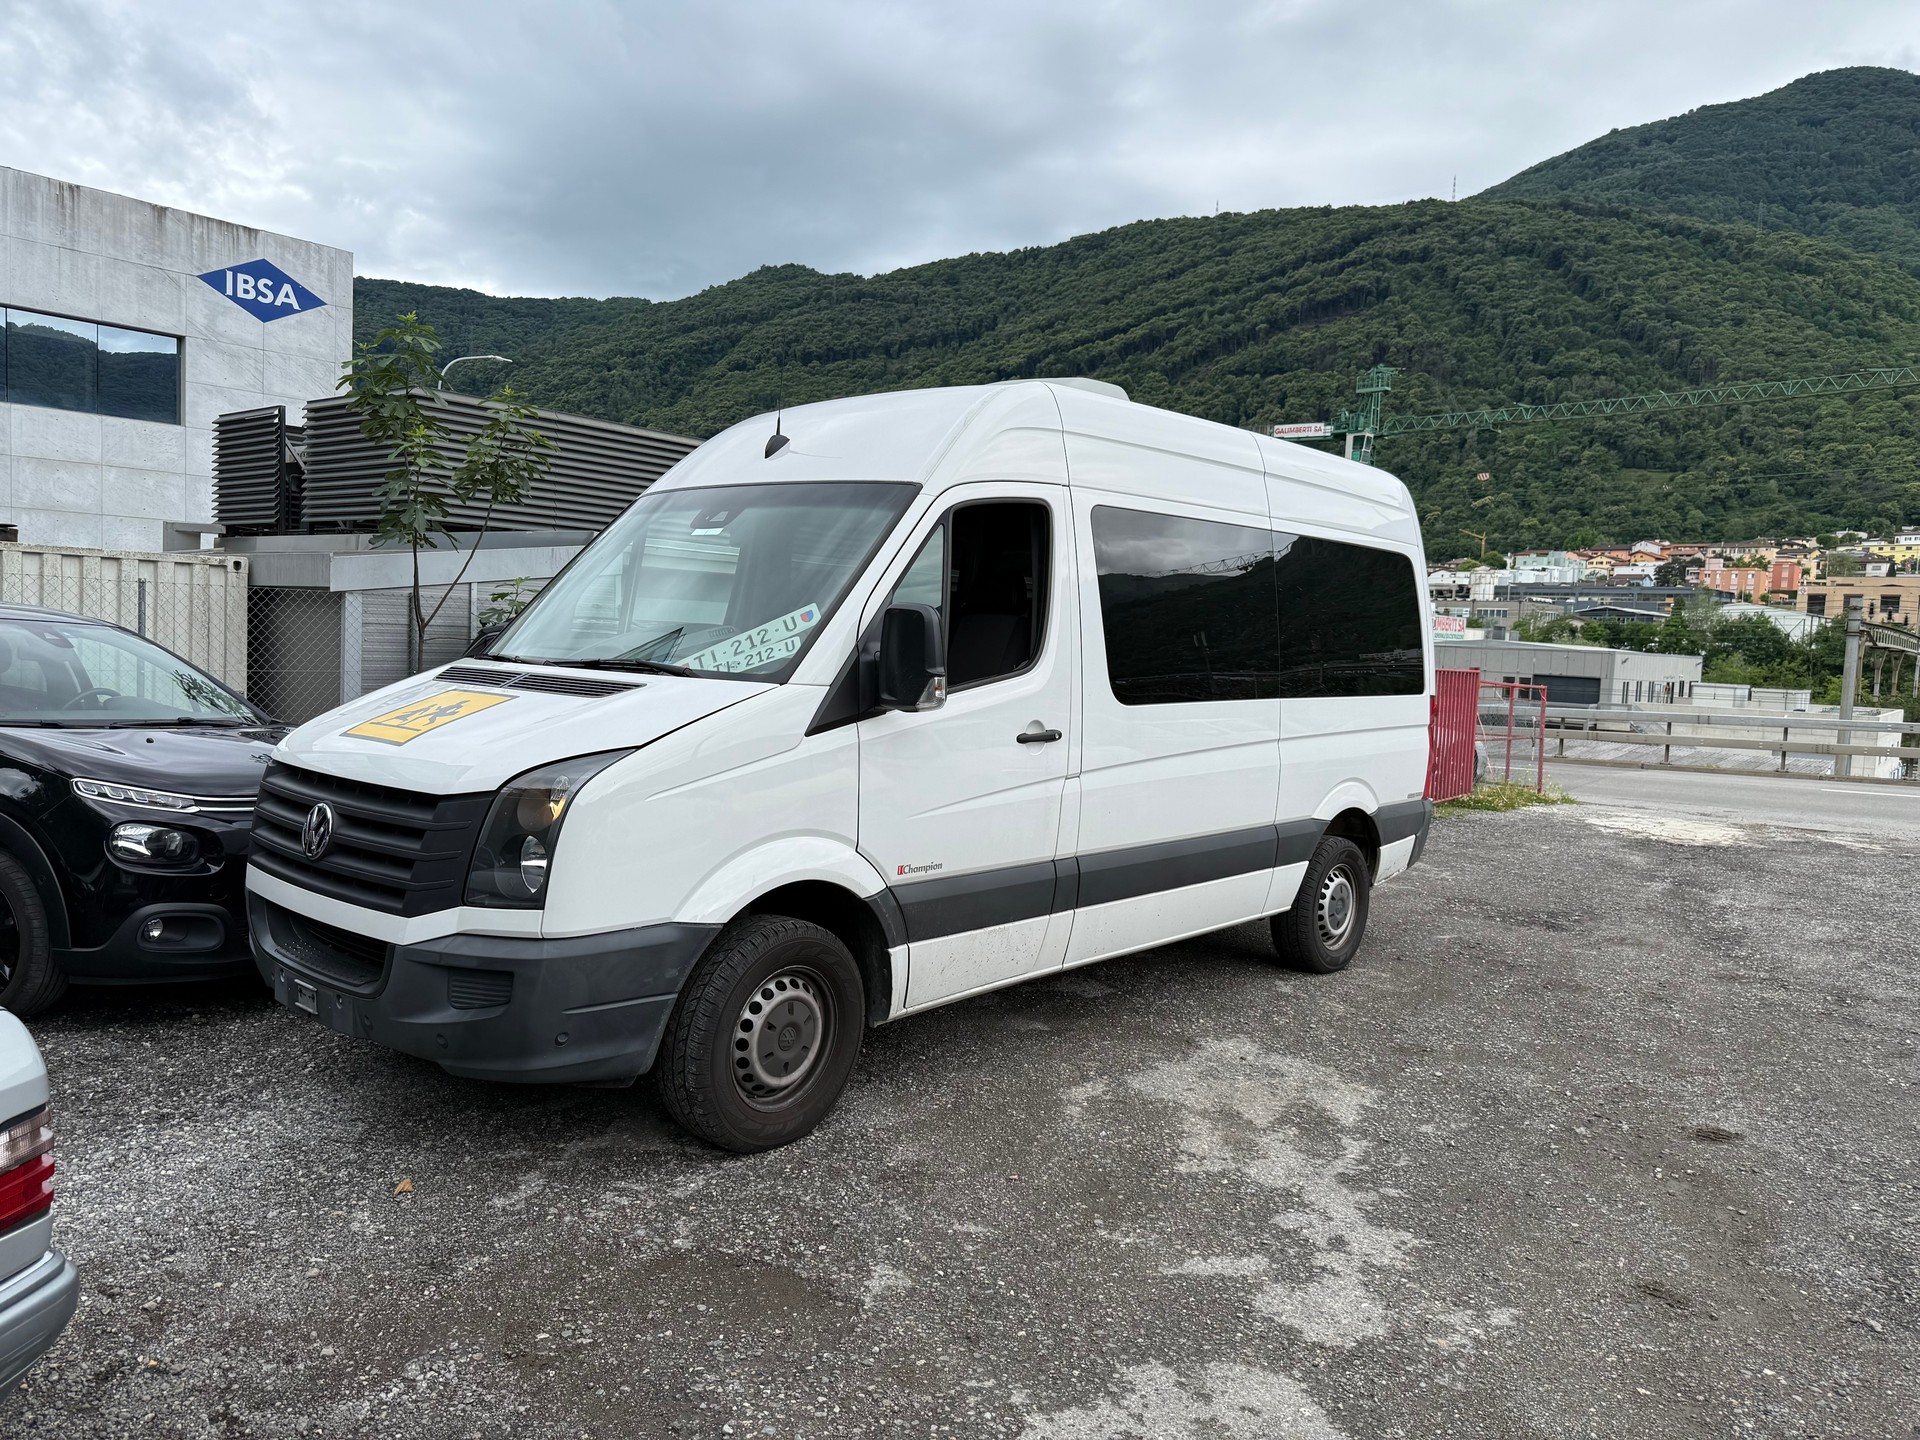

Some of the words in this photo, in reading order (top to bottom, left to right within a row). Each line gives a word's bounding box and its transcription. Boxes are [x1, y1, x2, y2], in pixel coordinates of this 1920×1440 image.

[225, 269, 301, 310] IBSA
[1313, 425, 1323, 433] SA
[903, 861, 943, 874] Champion
